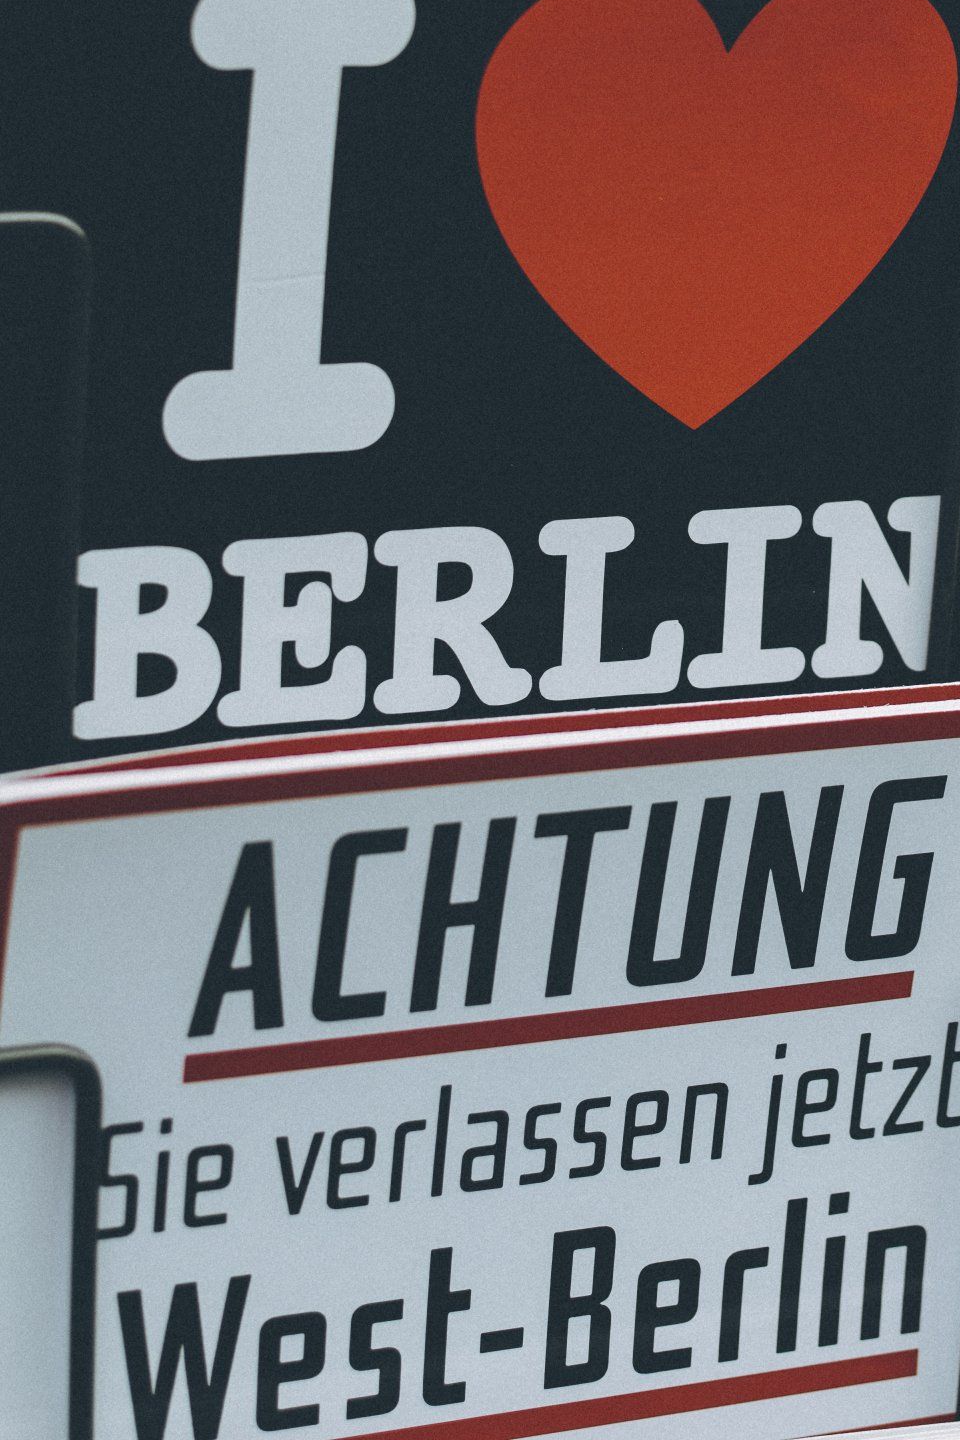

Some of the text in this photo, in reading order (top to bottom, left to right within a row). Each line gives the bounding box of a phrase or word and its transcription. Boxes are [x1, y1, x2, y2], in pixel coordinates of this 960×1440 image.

[72, 495, 942, 741] BERLIN
[187, 775, 948, 1038] ACHTUNG
[97, 1117, 234, 1241] Sie
[275, 1084, 730, 1216] verlassen
[117, 1192, 927, 1440] West-Berlin
